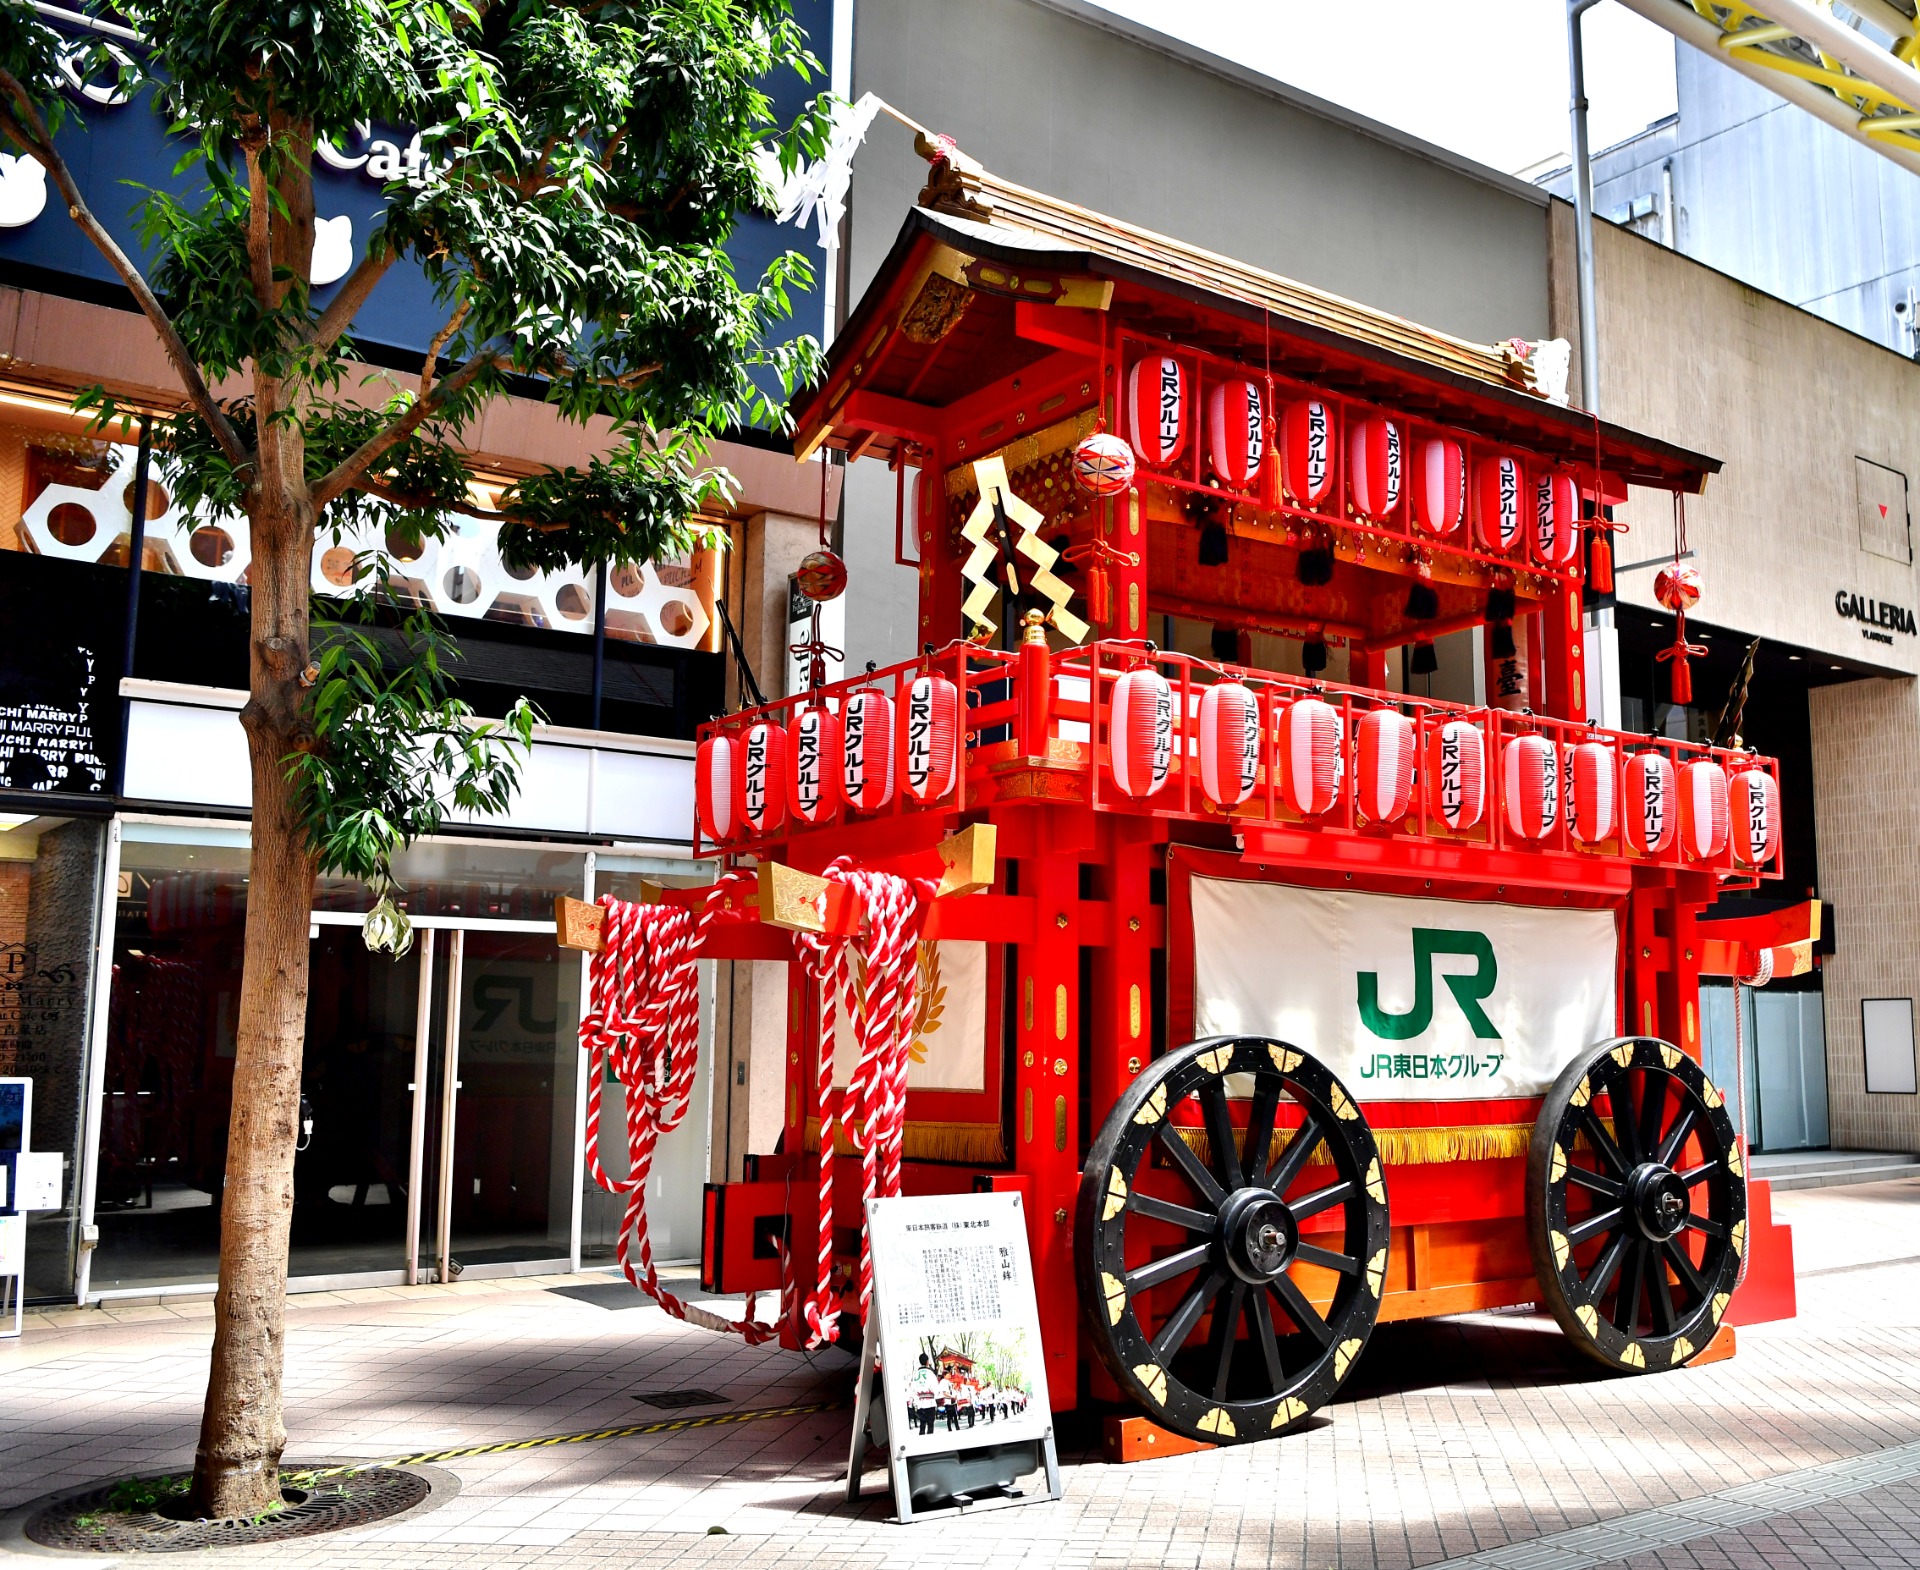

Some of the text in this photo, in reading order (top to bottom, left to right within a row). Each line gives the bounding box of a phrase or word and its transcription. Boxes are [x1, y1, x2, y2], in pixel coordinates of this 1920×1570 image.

[1158, 360, 1182, 449] JRグループ
[1308, 403, 1328, 487] JRグループ
[1500, 459, 1518, 538] JRグループ
[1537, 475, 1556, 550] JRグループ
[1835, 590, 1917, 637] GALLERIA
[11, 720, 63, 735] MARRY
[26, 709, 78, 723] MARRY
[37, 737, 87, 751] MARRY
[844, 698, 869, 797] JRグループ
[906, 684, 938, 787] JRグループ
[746, 731, 771, 821] JRグループ
[797, 718, 824, 811] JRグループ
[1441, 729, 1465, 818] JRグループ
[1563, 752, 1579, 832] JRグループ
[1644, 760, 1666, 844] JRグループ
[1749, 777, 1770, 853] JRグループ
[1356, 927, 1503, 1040] JR
[1360, 1053, 1505, 1080] JR東日本グループ
